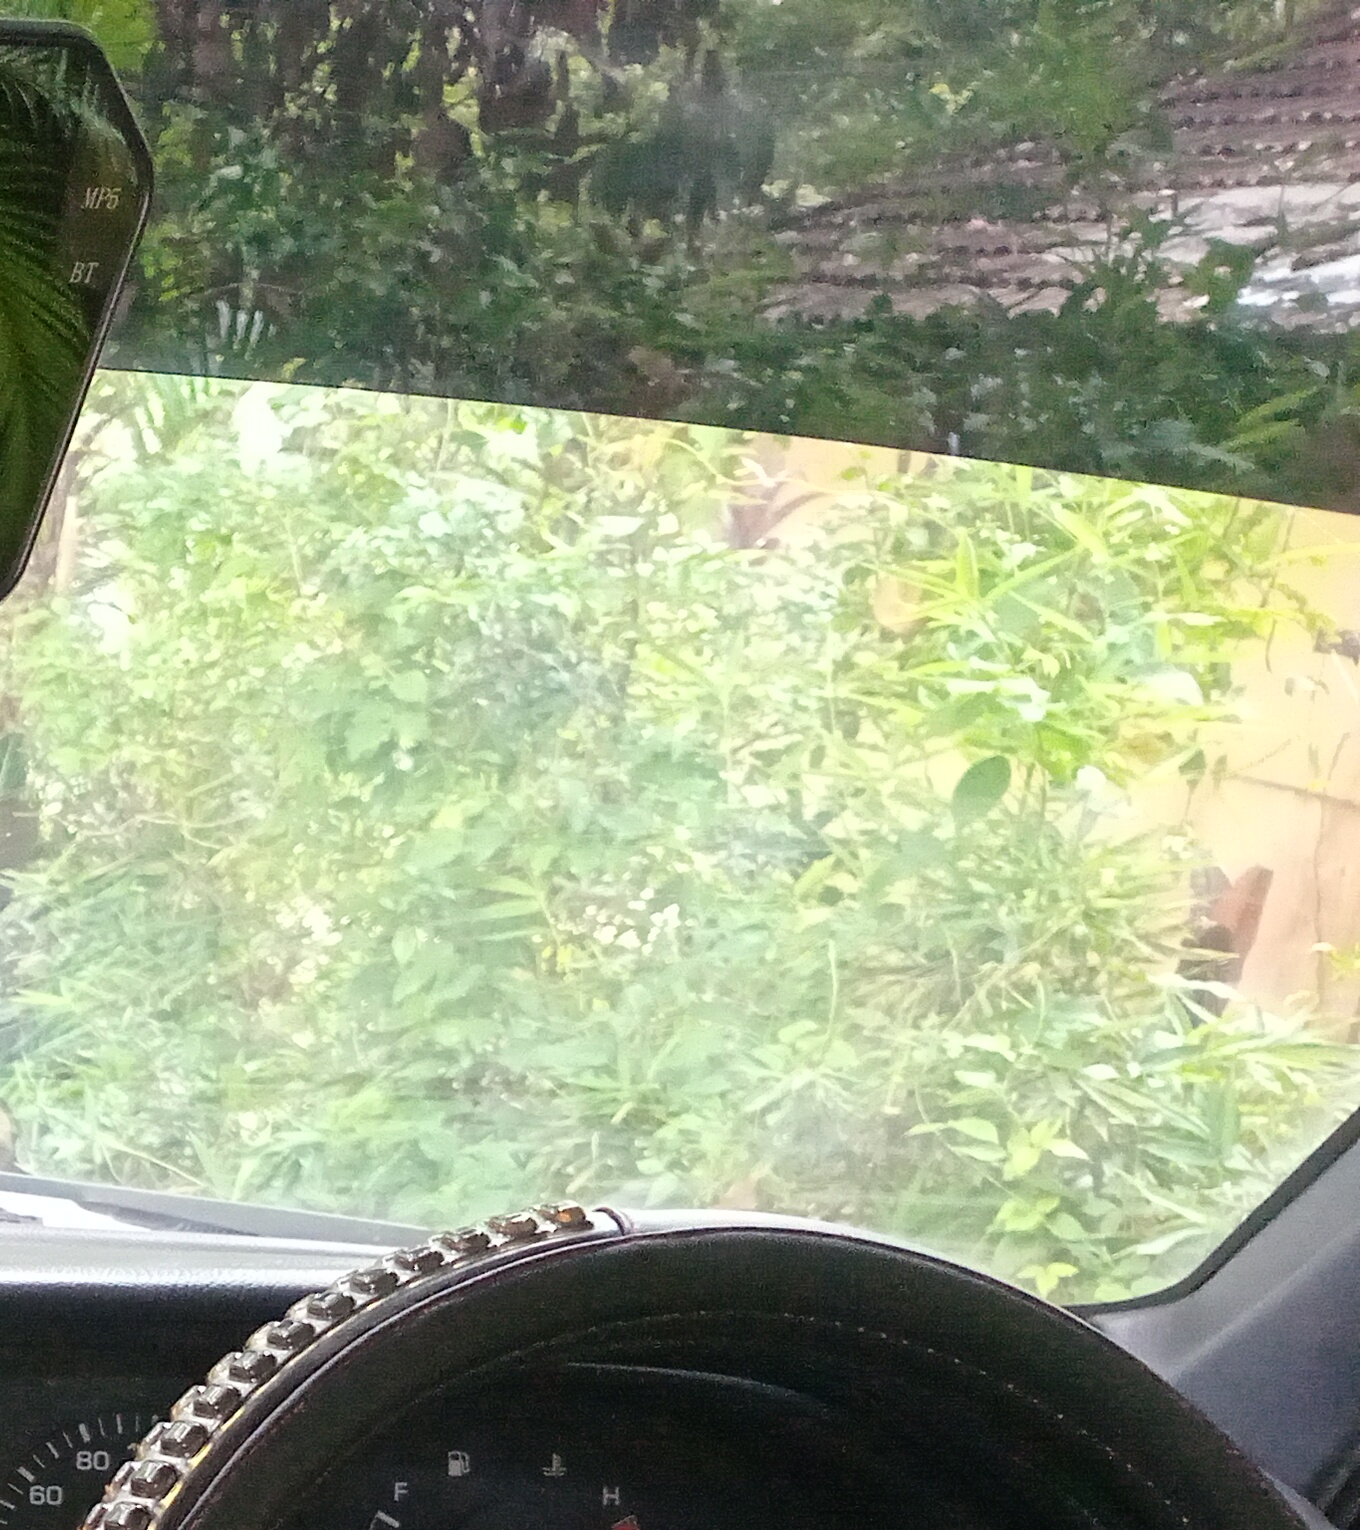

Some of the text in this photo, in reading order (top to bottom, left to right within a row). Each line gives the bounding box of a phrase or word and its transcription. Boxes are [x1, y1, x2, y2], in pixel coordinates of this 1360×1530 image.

[68, 260, 100, 283] BT
[75, 1450, 111, 1471] 80
[28, 1484, 65, 1506] 60
[394, 1482, 409, 1501] F
[602, 1486, 620, 1506] H
